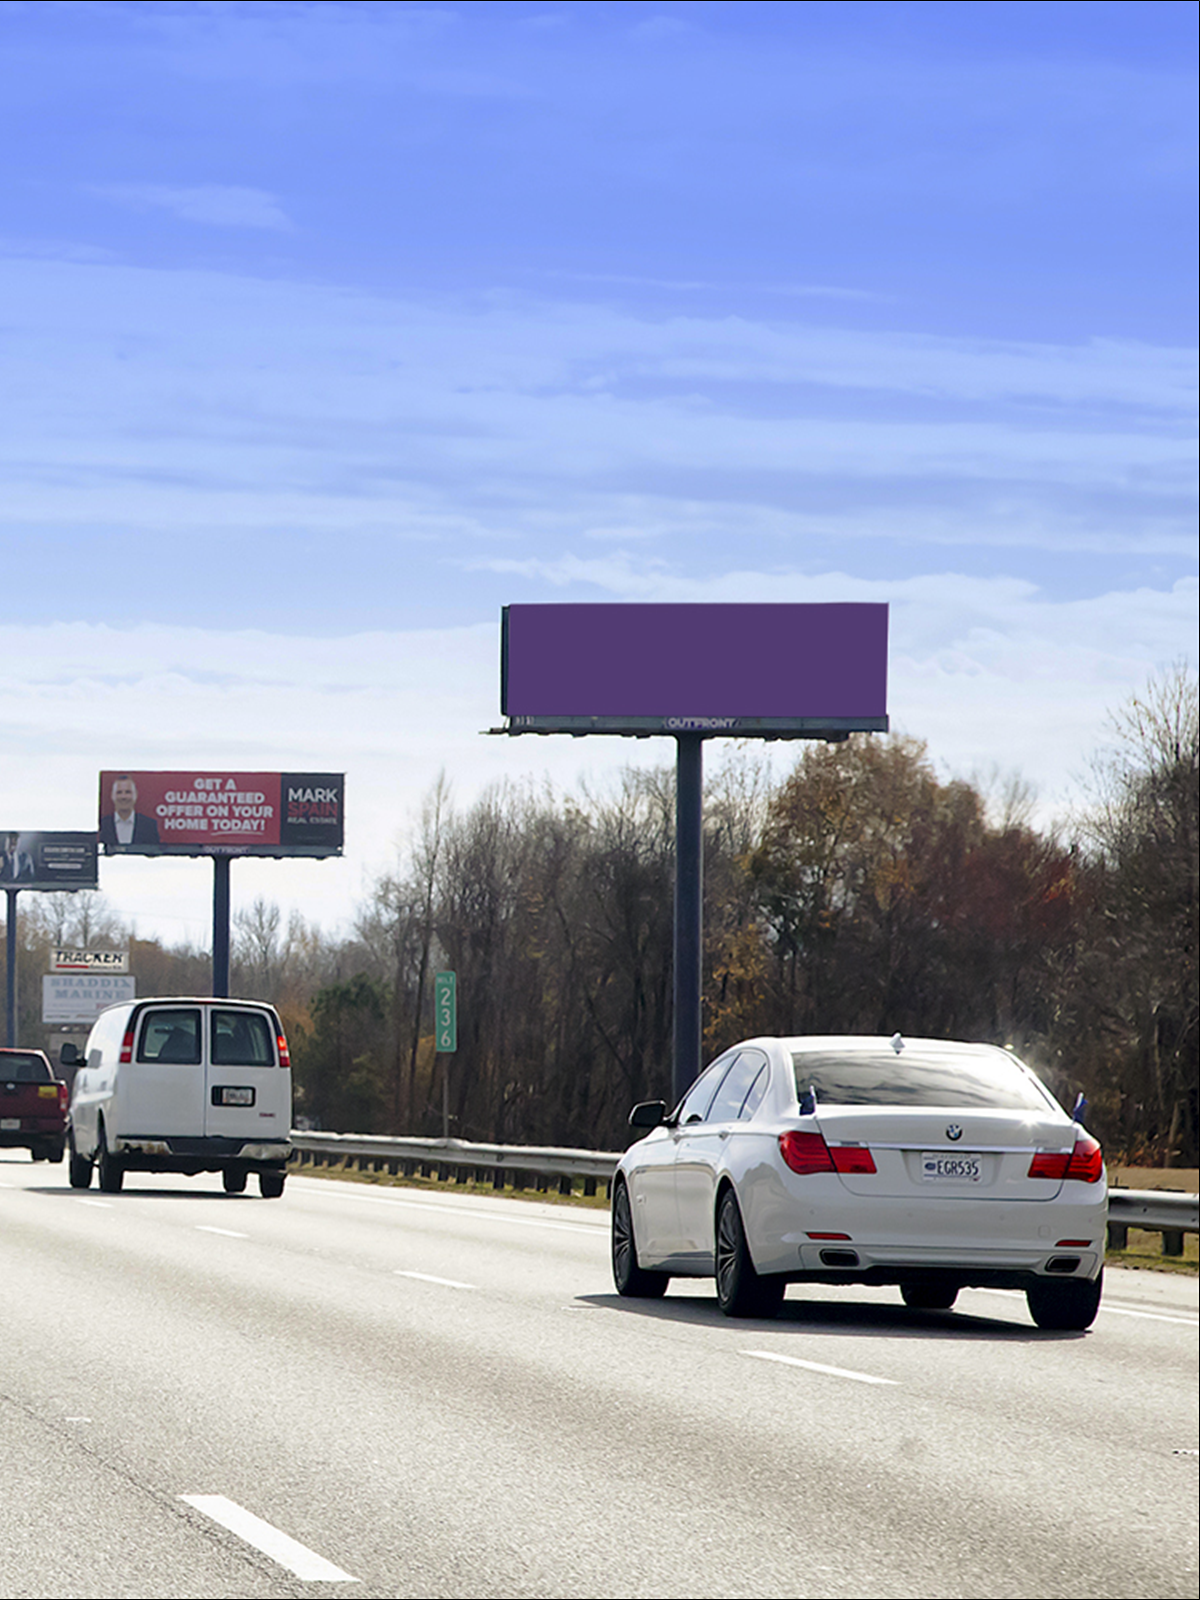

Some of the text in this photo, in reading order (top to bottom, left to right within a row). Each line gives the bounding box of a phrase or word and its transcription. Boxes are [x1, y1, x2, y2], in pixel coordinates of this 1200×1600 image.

[667, 717, 736, 728] OUTFRONT
[194, 778, 236, 790] GET A
[165, 791, 265, 804] GUARANTEED
[288, 788, 338, 803] MARK
[156, 805, 273, 818] OFFER ON YOUR
[288, 802, 338, 817] SPAIN
[164, 818, 265, 831] HOME TODAY!
[56, 951, 124, 963] TRACKER
[55, 989, 126, 999] MARINE
[441, 987, 451, 1047] 236
